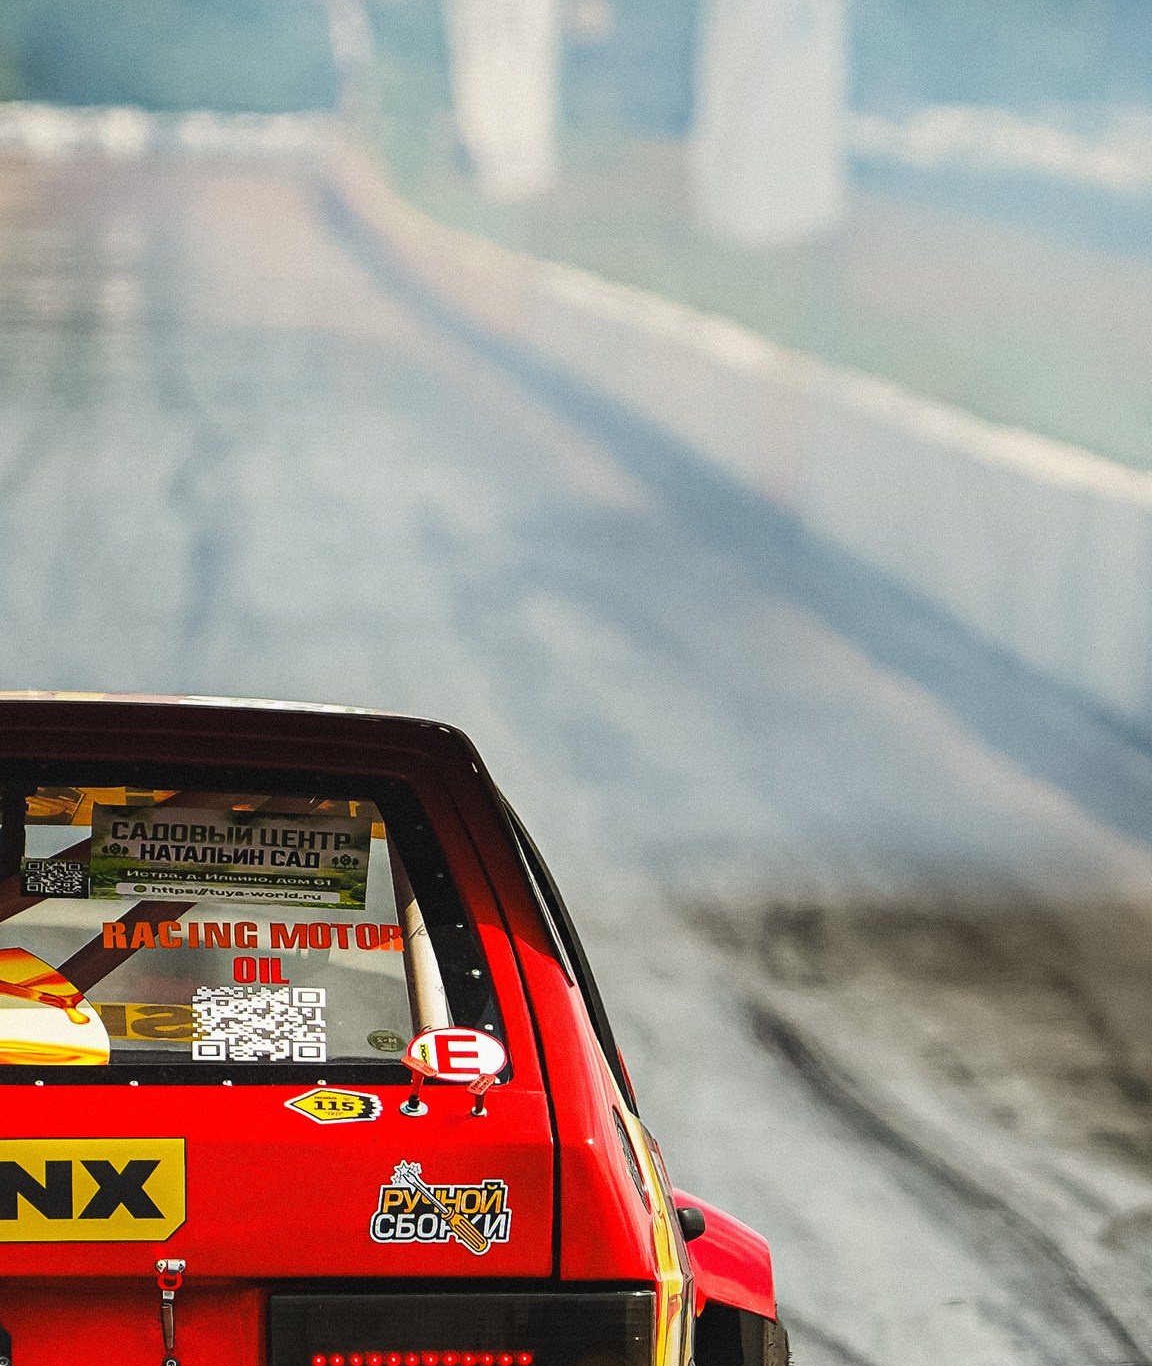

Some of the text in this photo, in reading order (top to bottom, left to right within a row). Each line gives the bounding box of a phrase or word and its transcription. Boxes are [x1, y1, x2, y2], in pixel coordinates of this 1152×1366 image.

[260, 825, 352, 851] ЦЕНТР
[139, 843, 320, 869] НАТАЛЬИН САД
[151, 885, 322, 901] https://tuya-world.ru
[276, 876, 310, 886] дом
[101, 921, 405, 952] RACING MOTOR
[232, 956, 290, 985] OIL
[434, 1034, 481, 1075] E
[313, 1100, 355, 1112] 115
